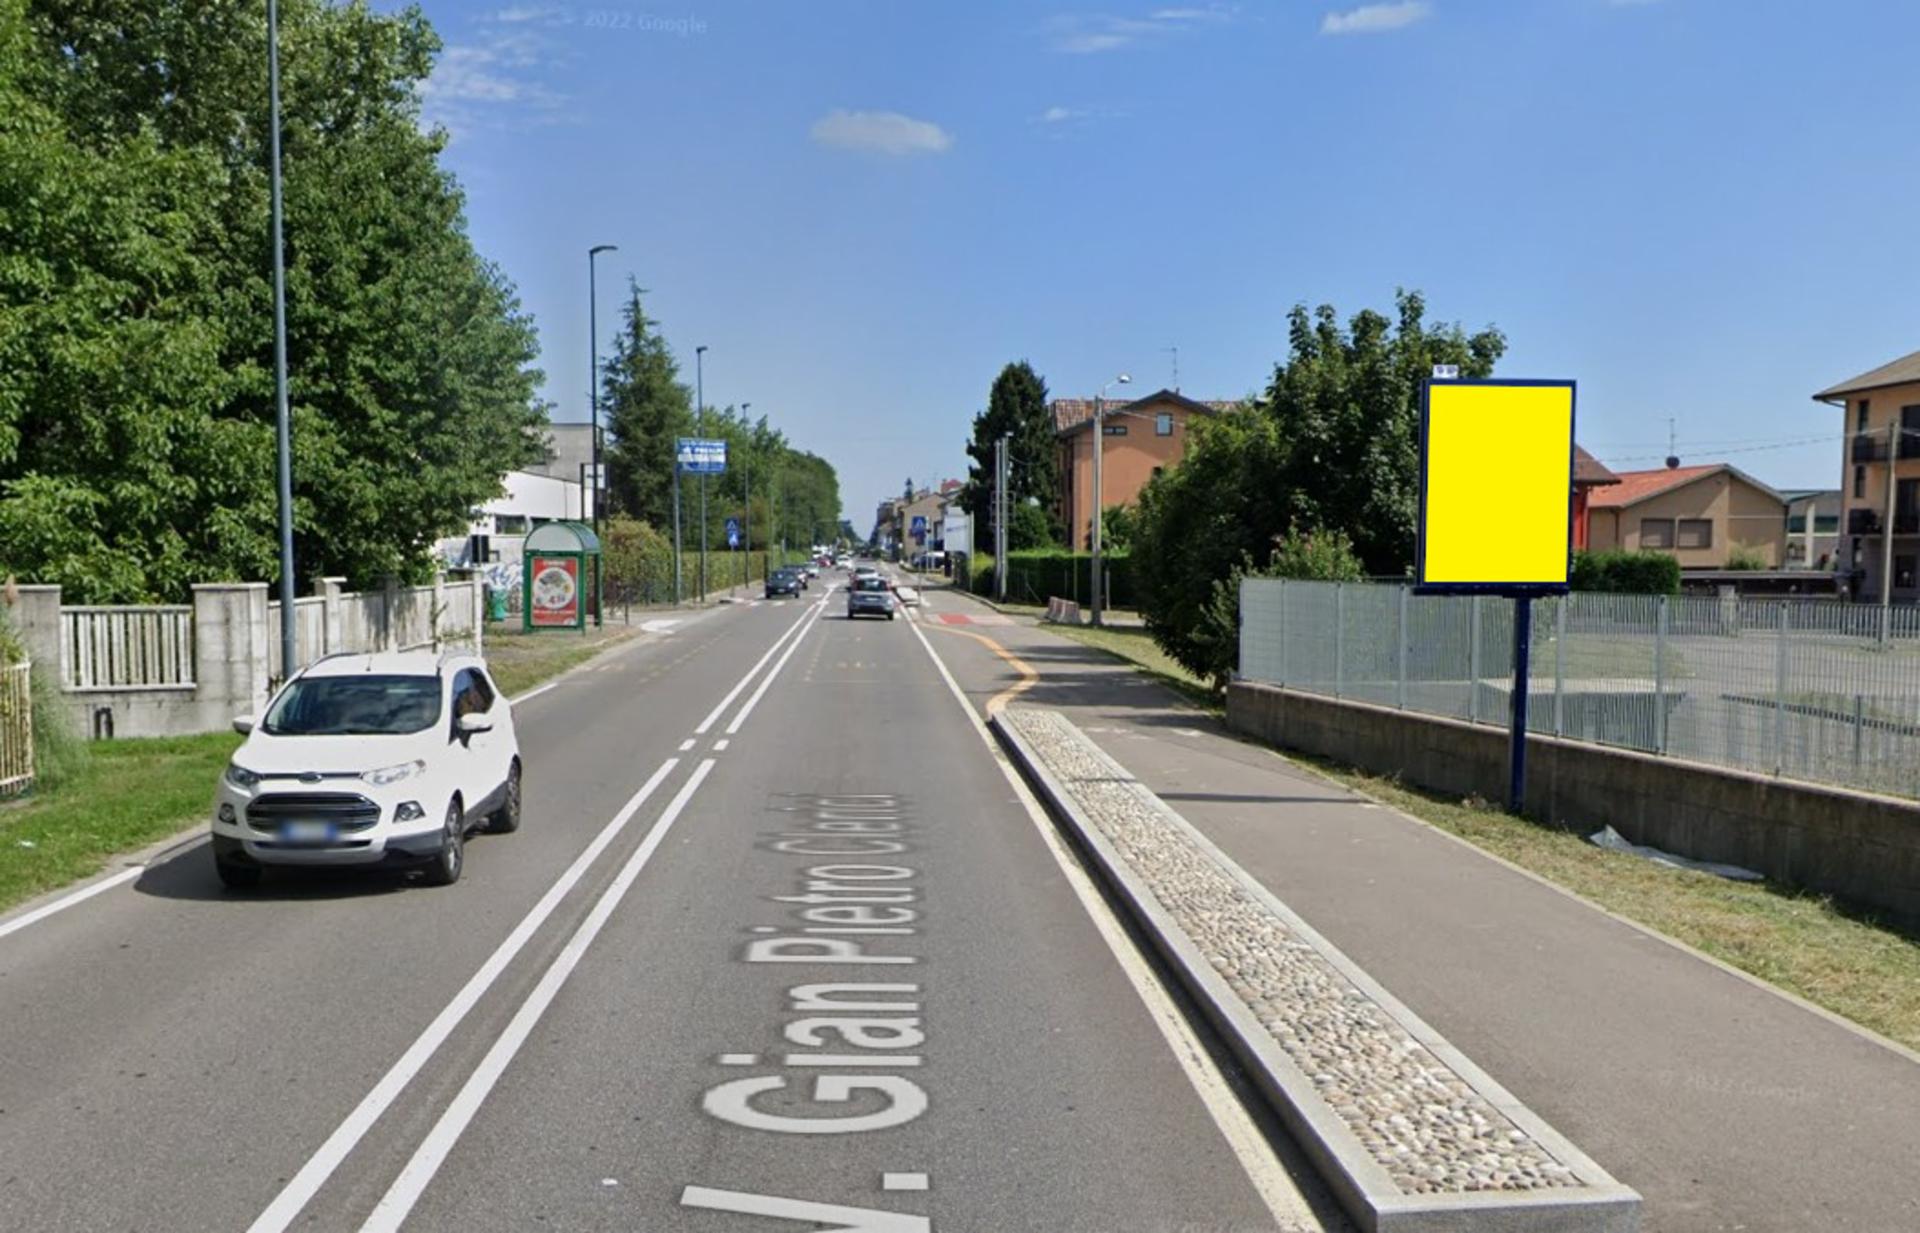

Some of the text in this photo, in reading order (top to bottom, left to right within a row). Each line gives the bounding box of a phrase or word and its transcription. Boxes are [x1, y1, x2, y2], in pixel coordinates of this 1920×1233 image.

[775, 792, 906, 855] Clerici
[747, 864, 917, 963] Pietro
[703, 982, 929, 1134] Gian
